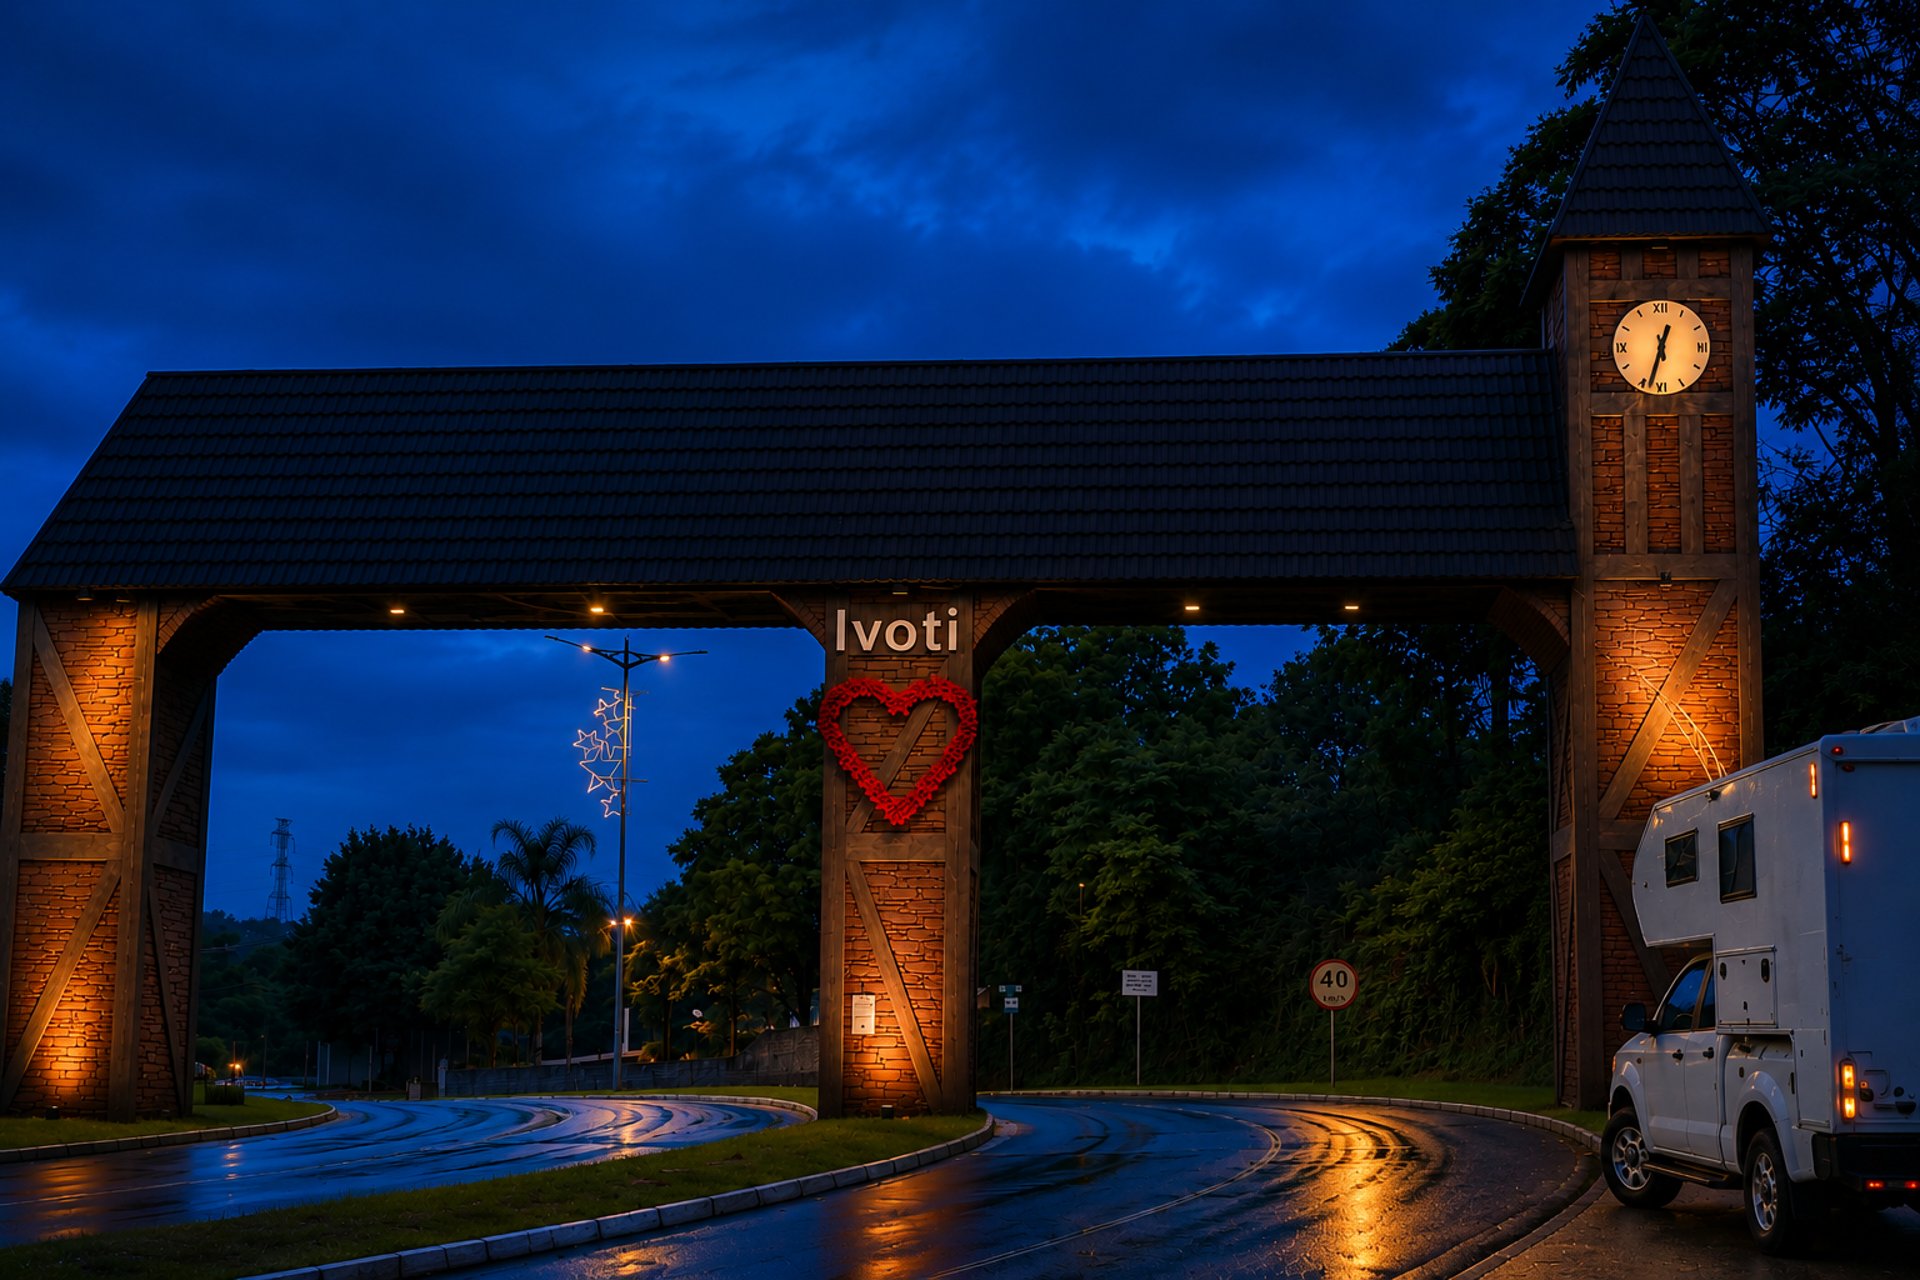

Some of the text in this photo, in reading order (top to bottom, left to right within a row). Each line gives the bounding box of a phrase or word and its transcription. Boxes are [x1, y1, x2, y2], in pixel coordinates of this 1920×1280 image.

[1653, 303, 1668, 313] XII
[1616, 342, 1627, 353] IX
[836, 607, 958, 651] Ivoti
[1320, 970, 1348, 988] 40
